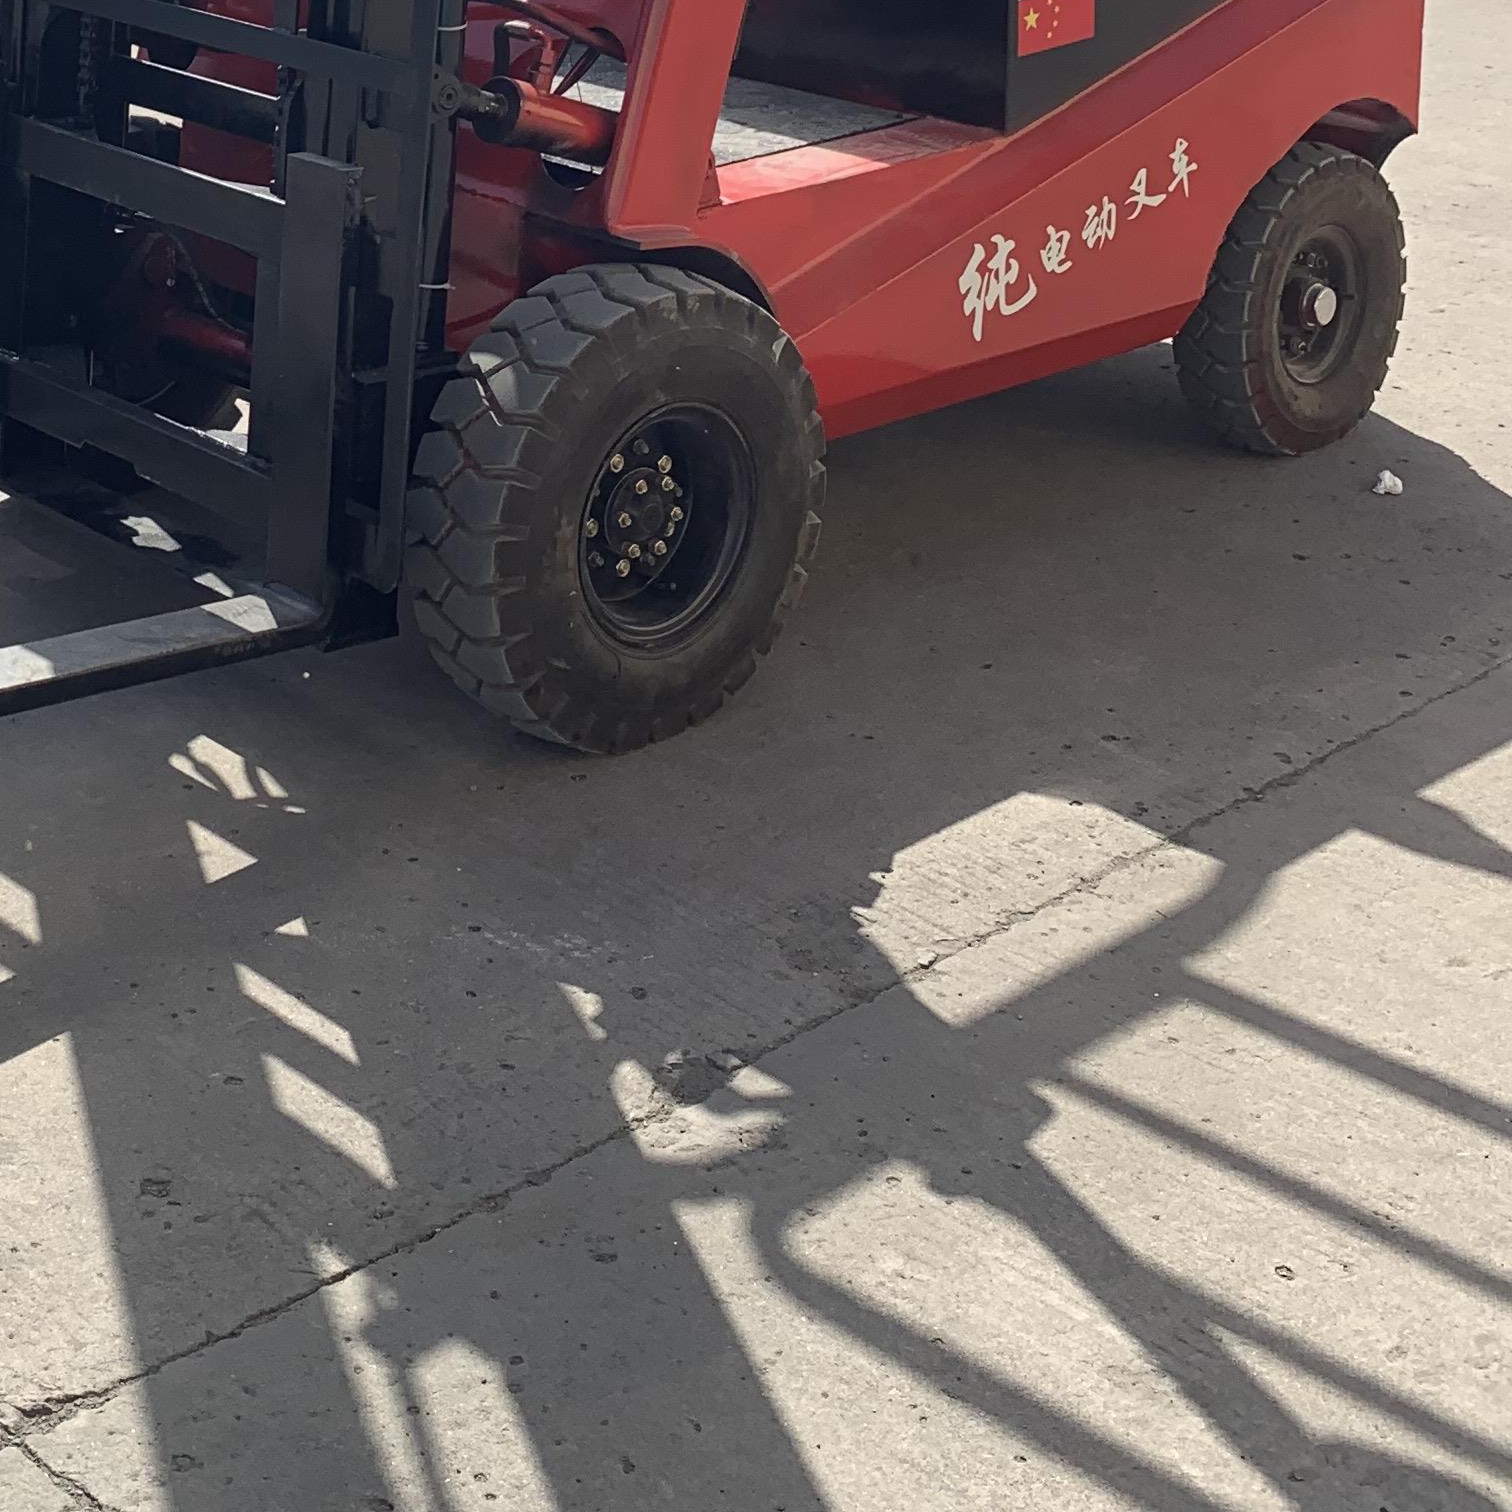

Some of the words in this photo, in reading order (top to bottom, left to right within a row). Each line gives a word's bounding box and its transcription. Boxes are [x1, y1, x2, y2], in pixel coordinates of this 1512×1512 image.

[958, 137, 1198, 341] 纯电动叉车
